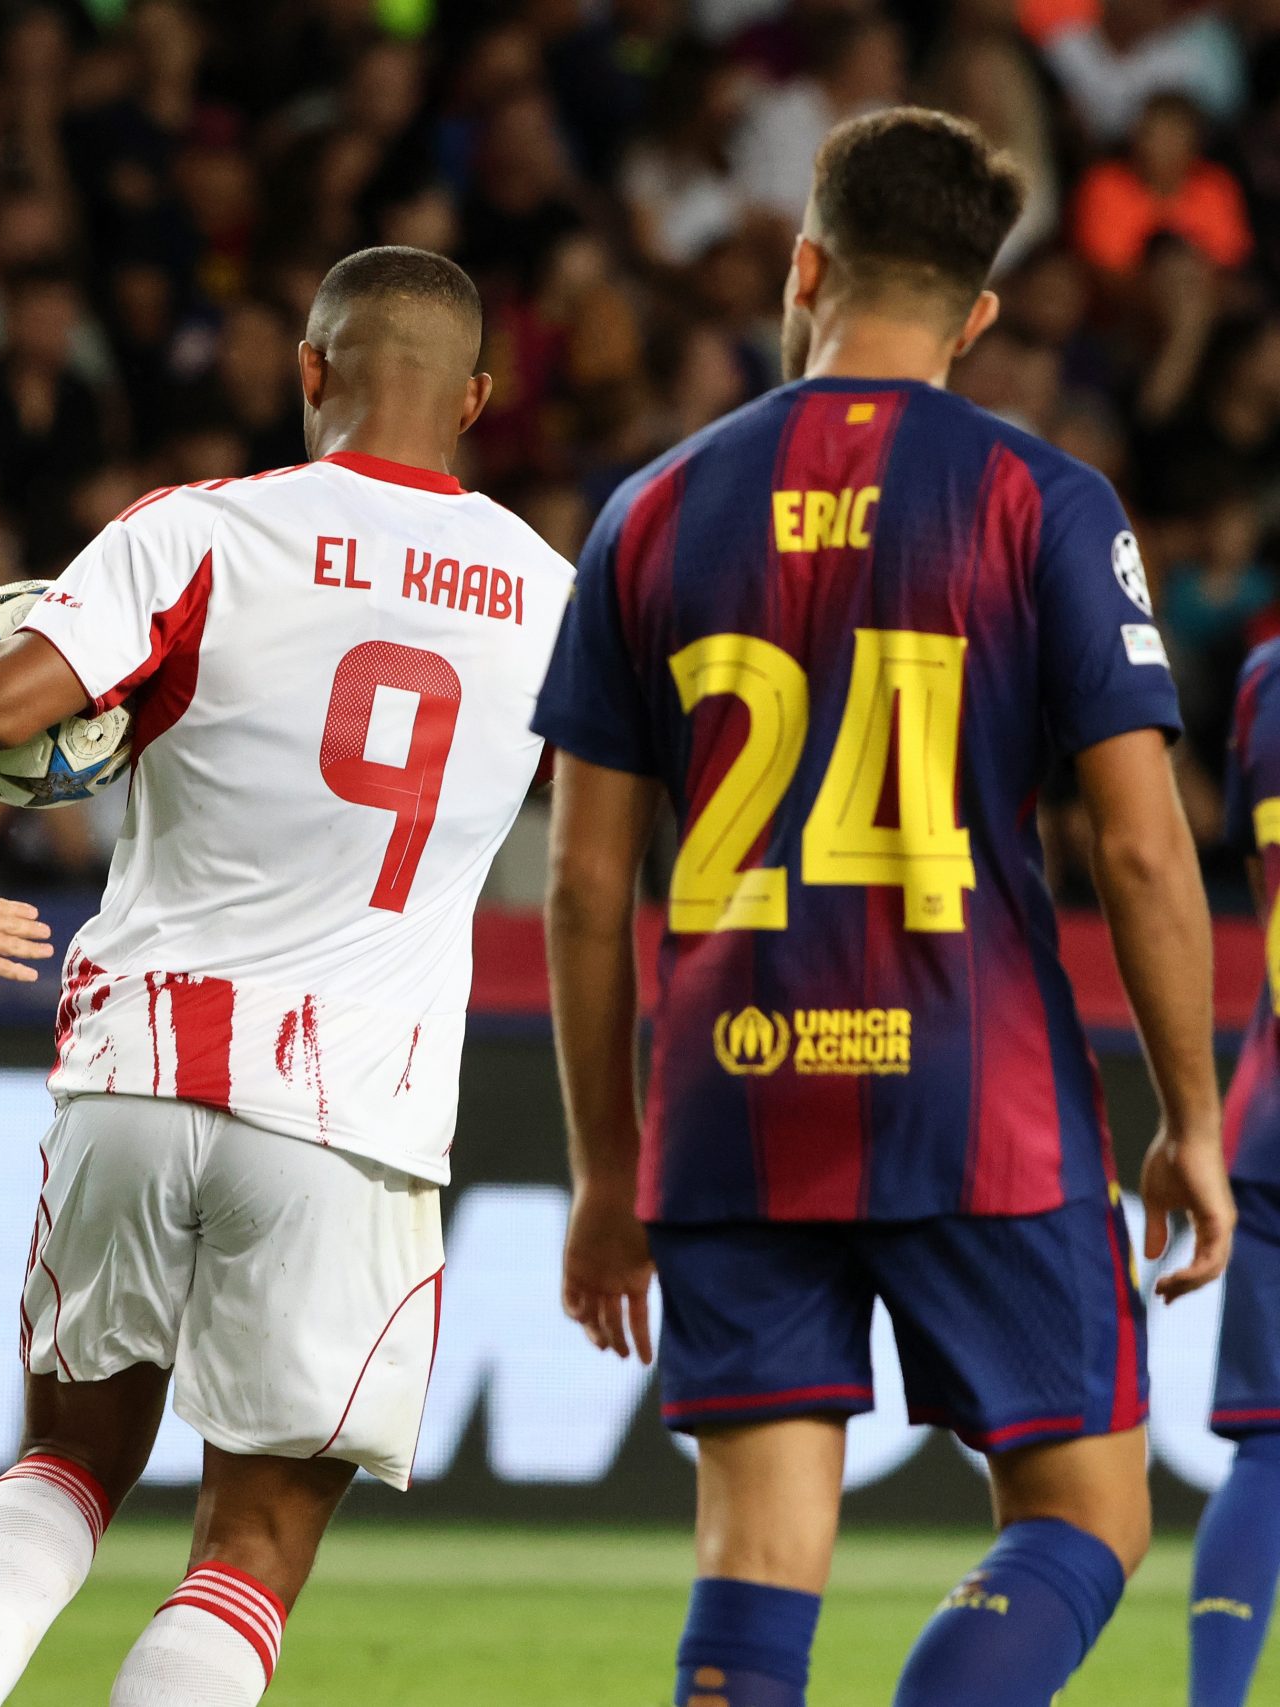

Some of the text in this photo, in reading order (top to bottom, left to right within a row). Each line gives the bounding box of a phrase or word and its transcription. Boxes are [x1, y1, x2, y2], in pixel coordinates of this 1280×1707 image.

[772, 486, 880, 553] ERIC
[314, 536, 524, 626] EL KAABI
[320, 640, 462, 914] 9
[668, 628, 976, 934] 24
[794, 1008, 911, 1035] UNHCR
[794, 1036, 910, 1062] ACNUR
